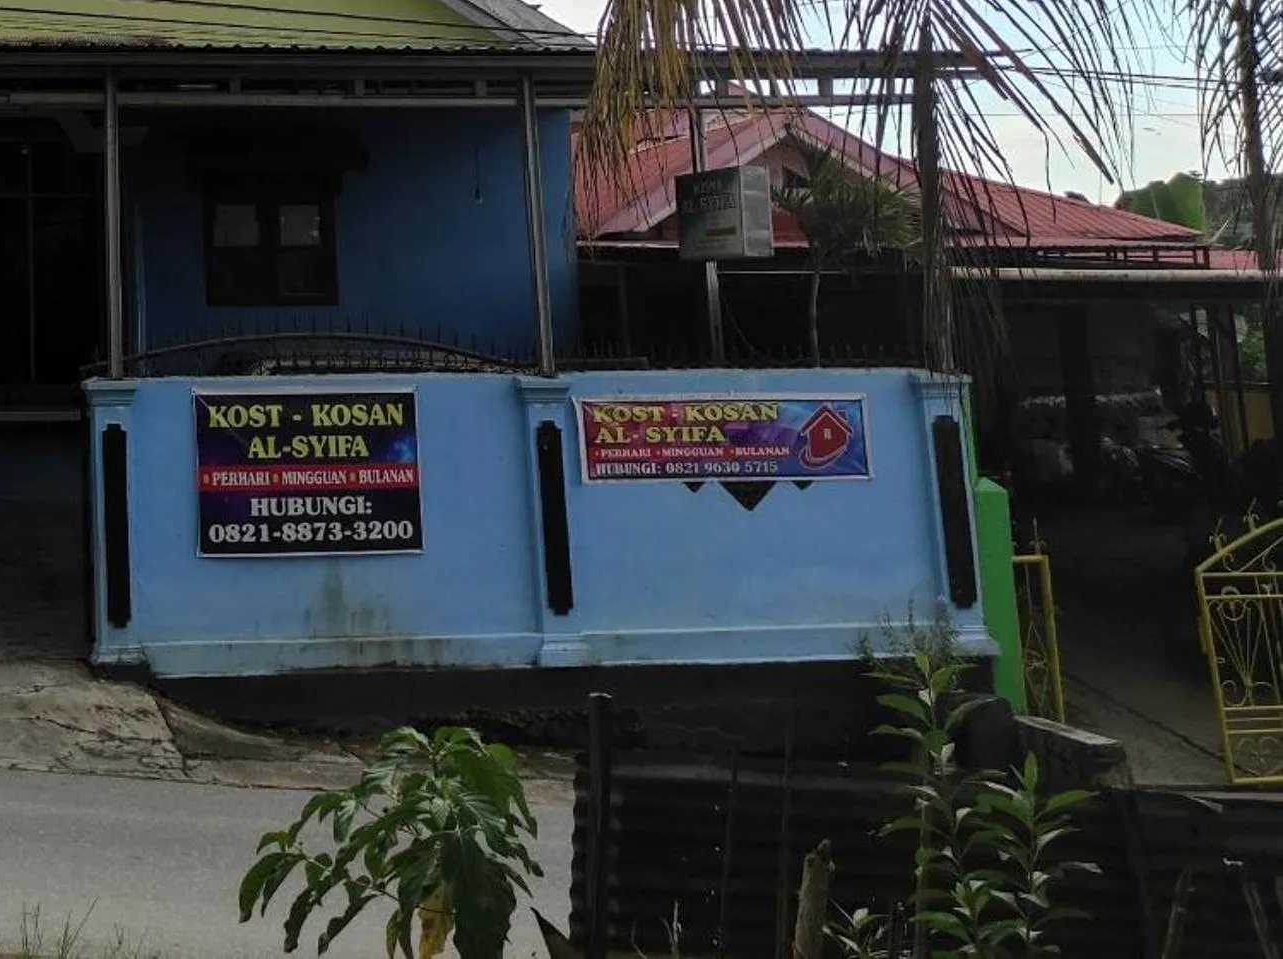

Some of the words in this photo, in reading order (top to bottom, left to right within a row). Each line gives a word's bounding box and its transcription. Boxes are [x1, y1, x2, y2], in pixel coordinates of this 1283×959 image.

[208, 404, 283, 428] KOST
[311, 403, 404, 427] KOSAN
[592, 406, 665, 423] KOST
[684, 404, 778, 421] KOSAN
[645, 426, 726, 443] SYIFA
[247, 435, 370, 459] AL-SYIFA
[212, 471, 270, 486] PERHARI
[281, 470, 347, 485] MINGGUAN
[358, 468, 414, 484] BULANAN
[666, 462, 701, 474] 0821
[744, 460, 778, 473] 5715
[249, 495, 373, 517] HUBUNGI:
[208, 520, 414, 543] 0821-8873-3200
